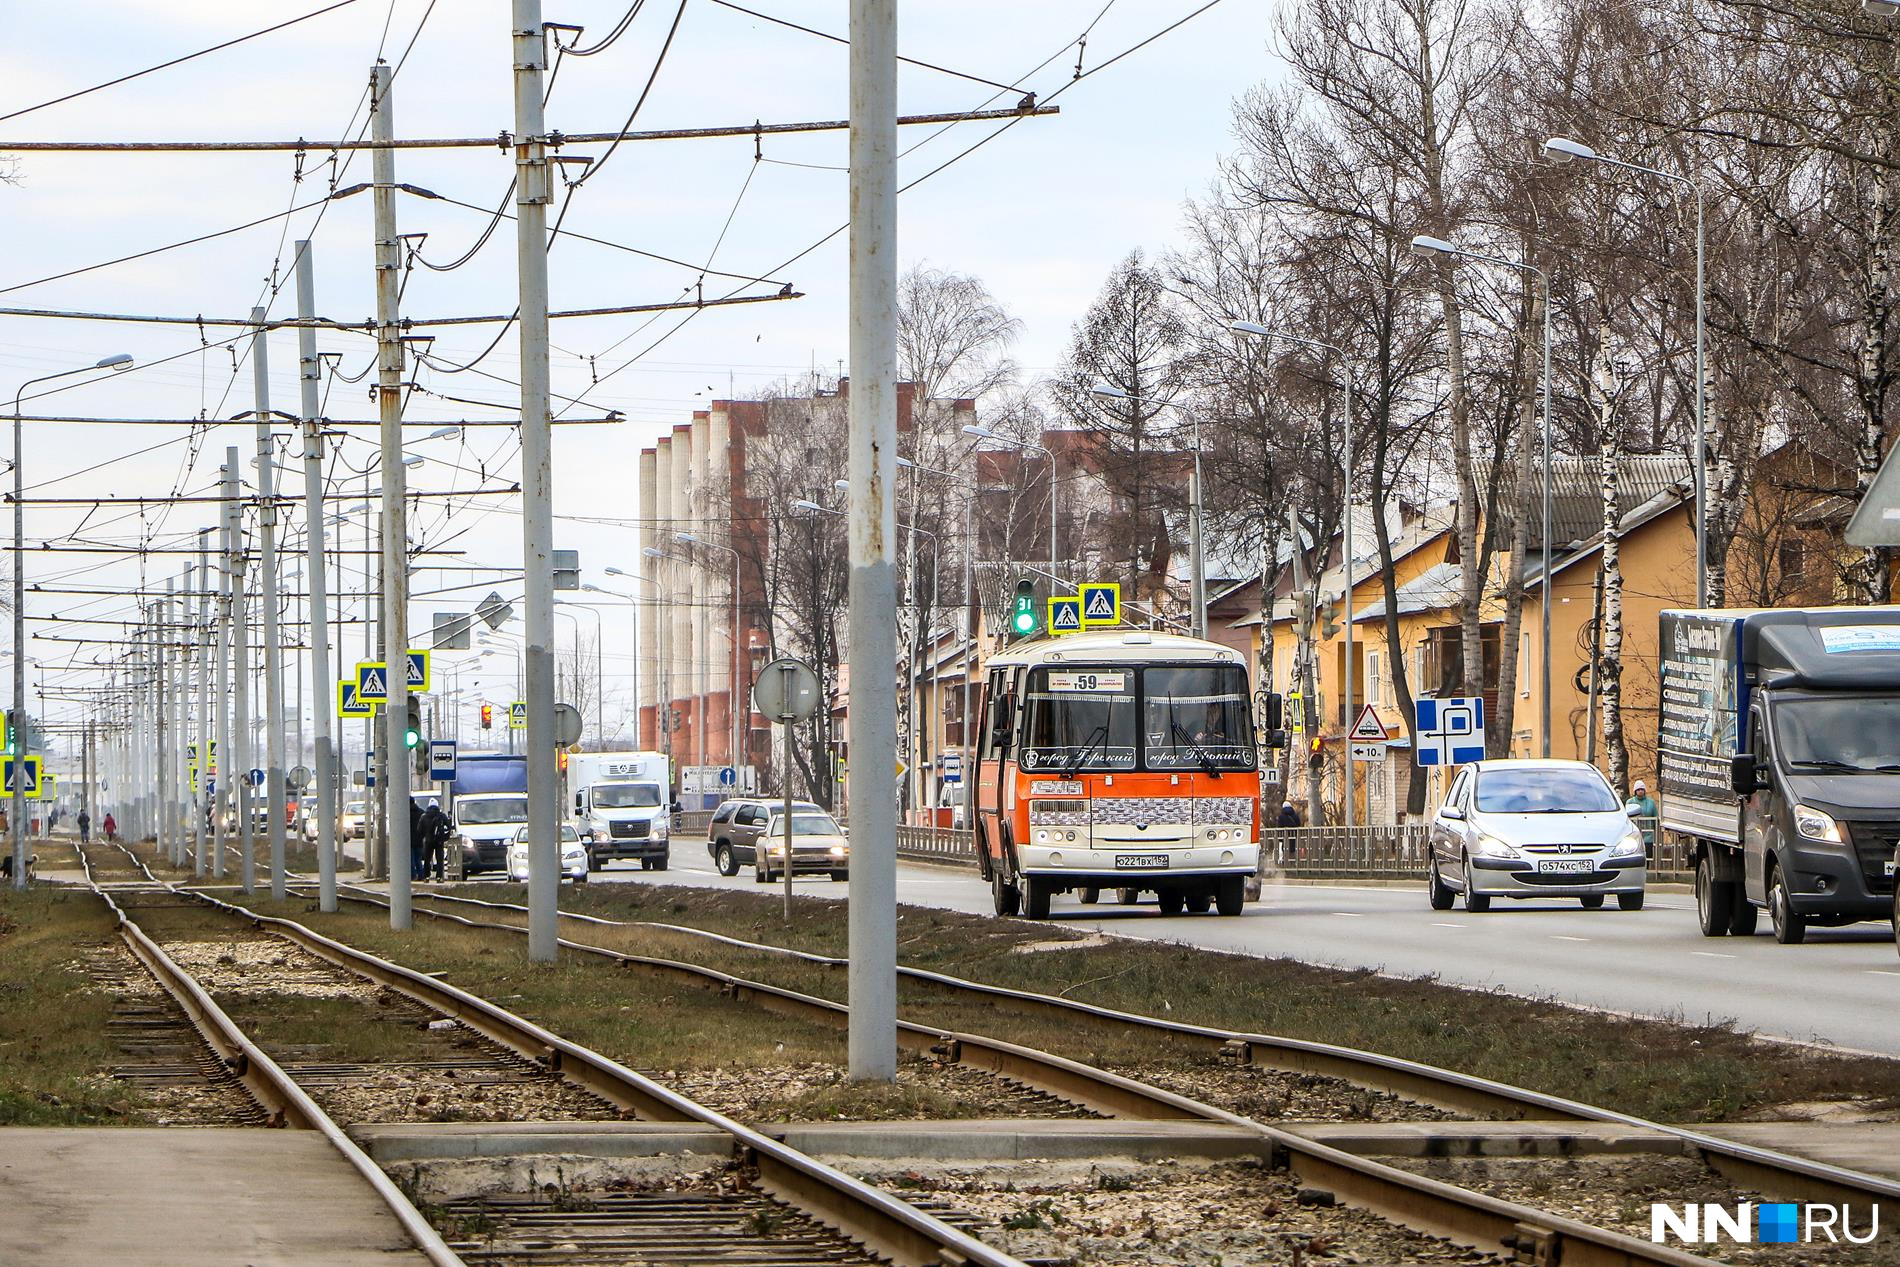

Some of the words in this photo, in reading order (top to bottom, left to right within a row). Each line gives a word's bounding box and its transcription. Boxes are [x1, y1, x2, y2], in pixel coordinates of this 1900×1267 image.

[1019, 597, 1032, 611] 31
[1366, 748, 1377, 757] 10
[1039, 753, 1070, 766] город
[1259, 770, 1276, 781] ОП
